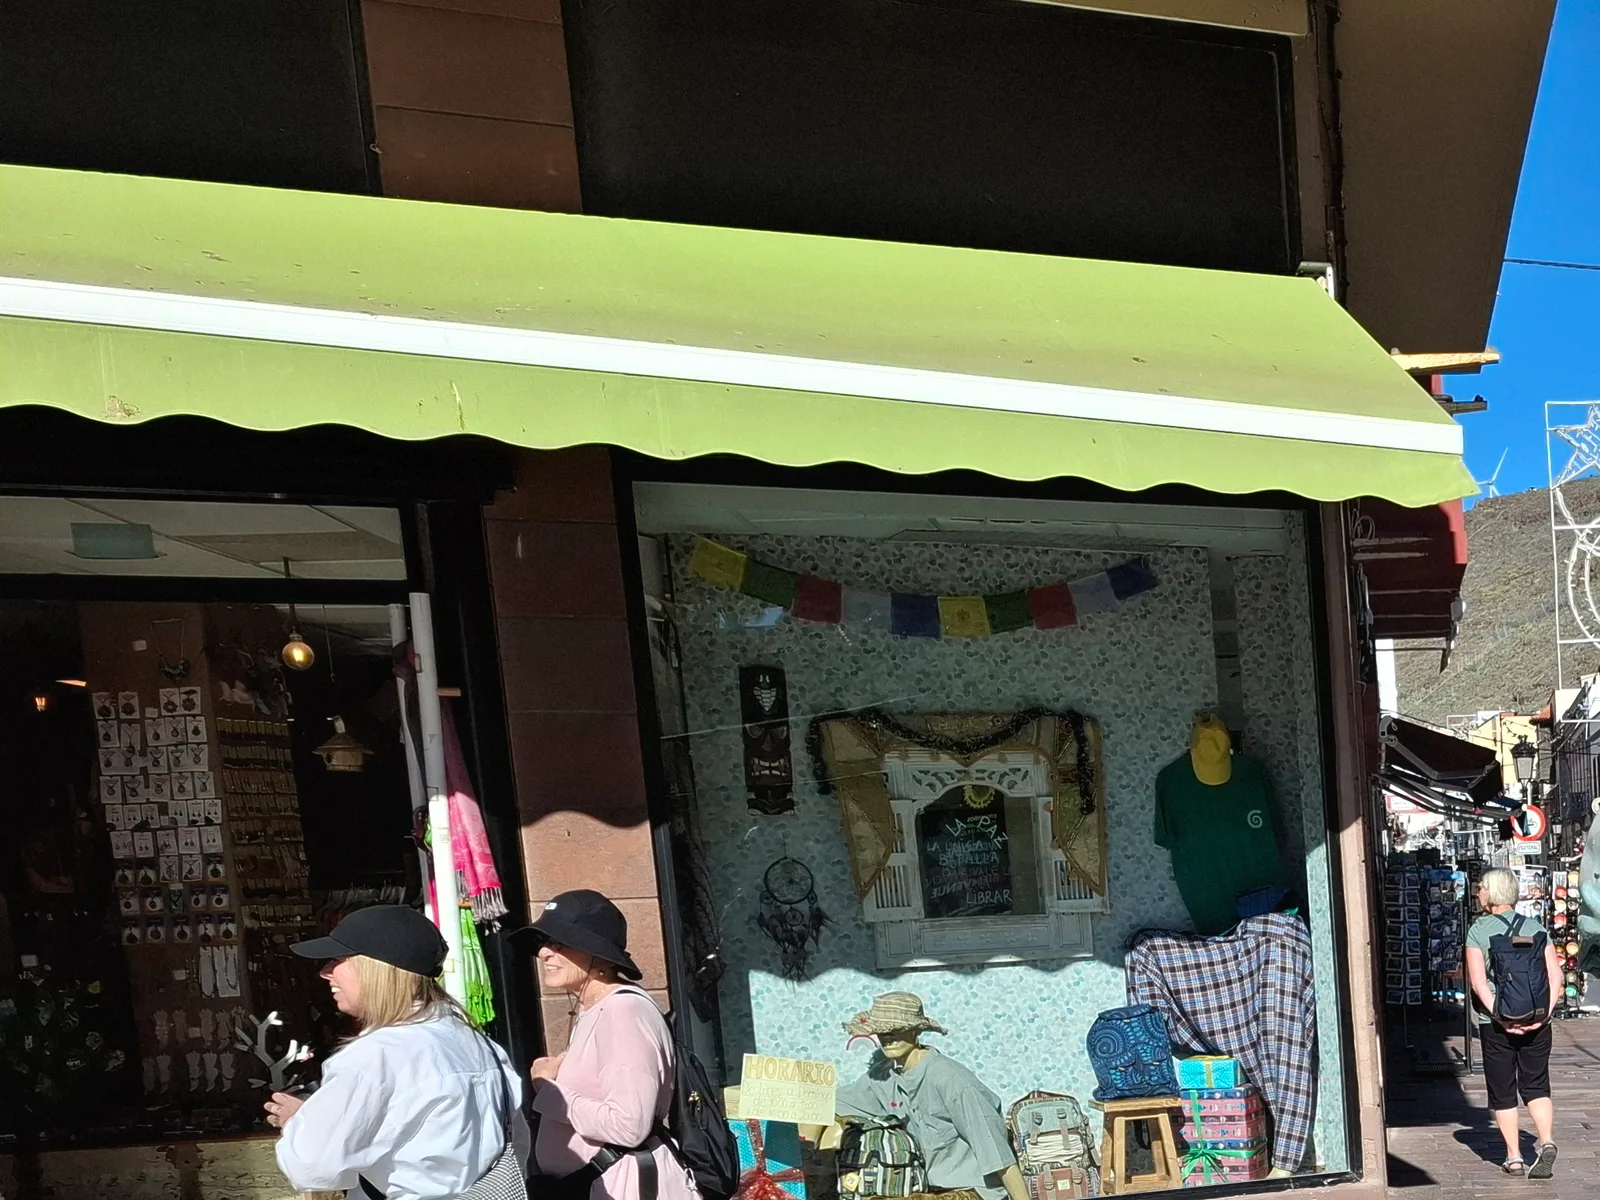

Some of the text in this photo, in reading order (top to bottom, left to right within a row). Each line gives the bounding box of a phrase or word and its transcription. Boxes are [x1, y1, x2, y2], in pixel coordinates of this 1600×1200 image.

[945, 816, 1009, 849] LA PAZ
[745, 1056, 835, 1085] HORARIO
